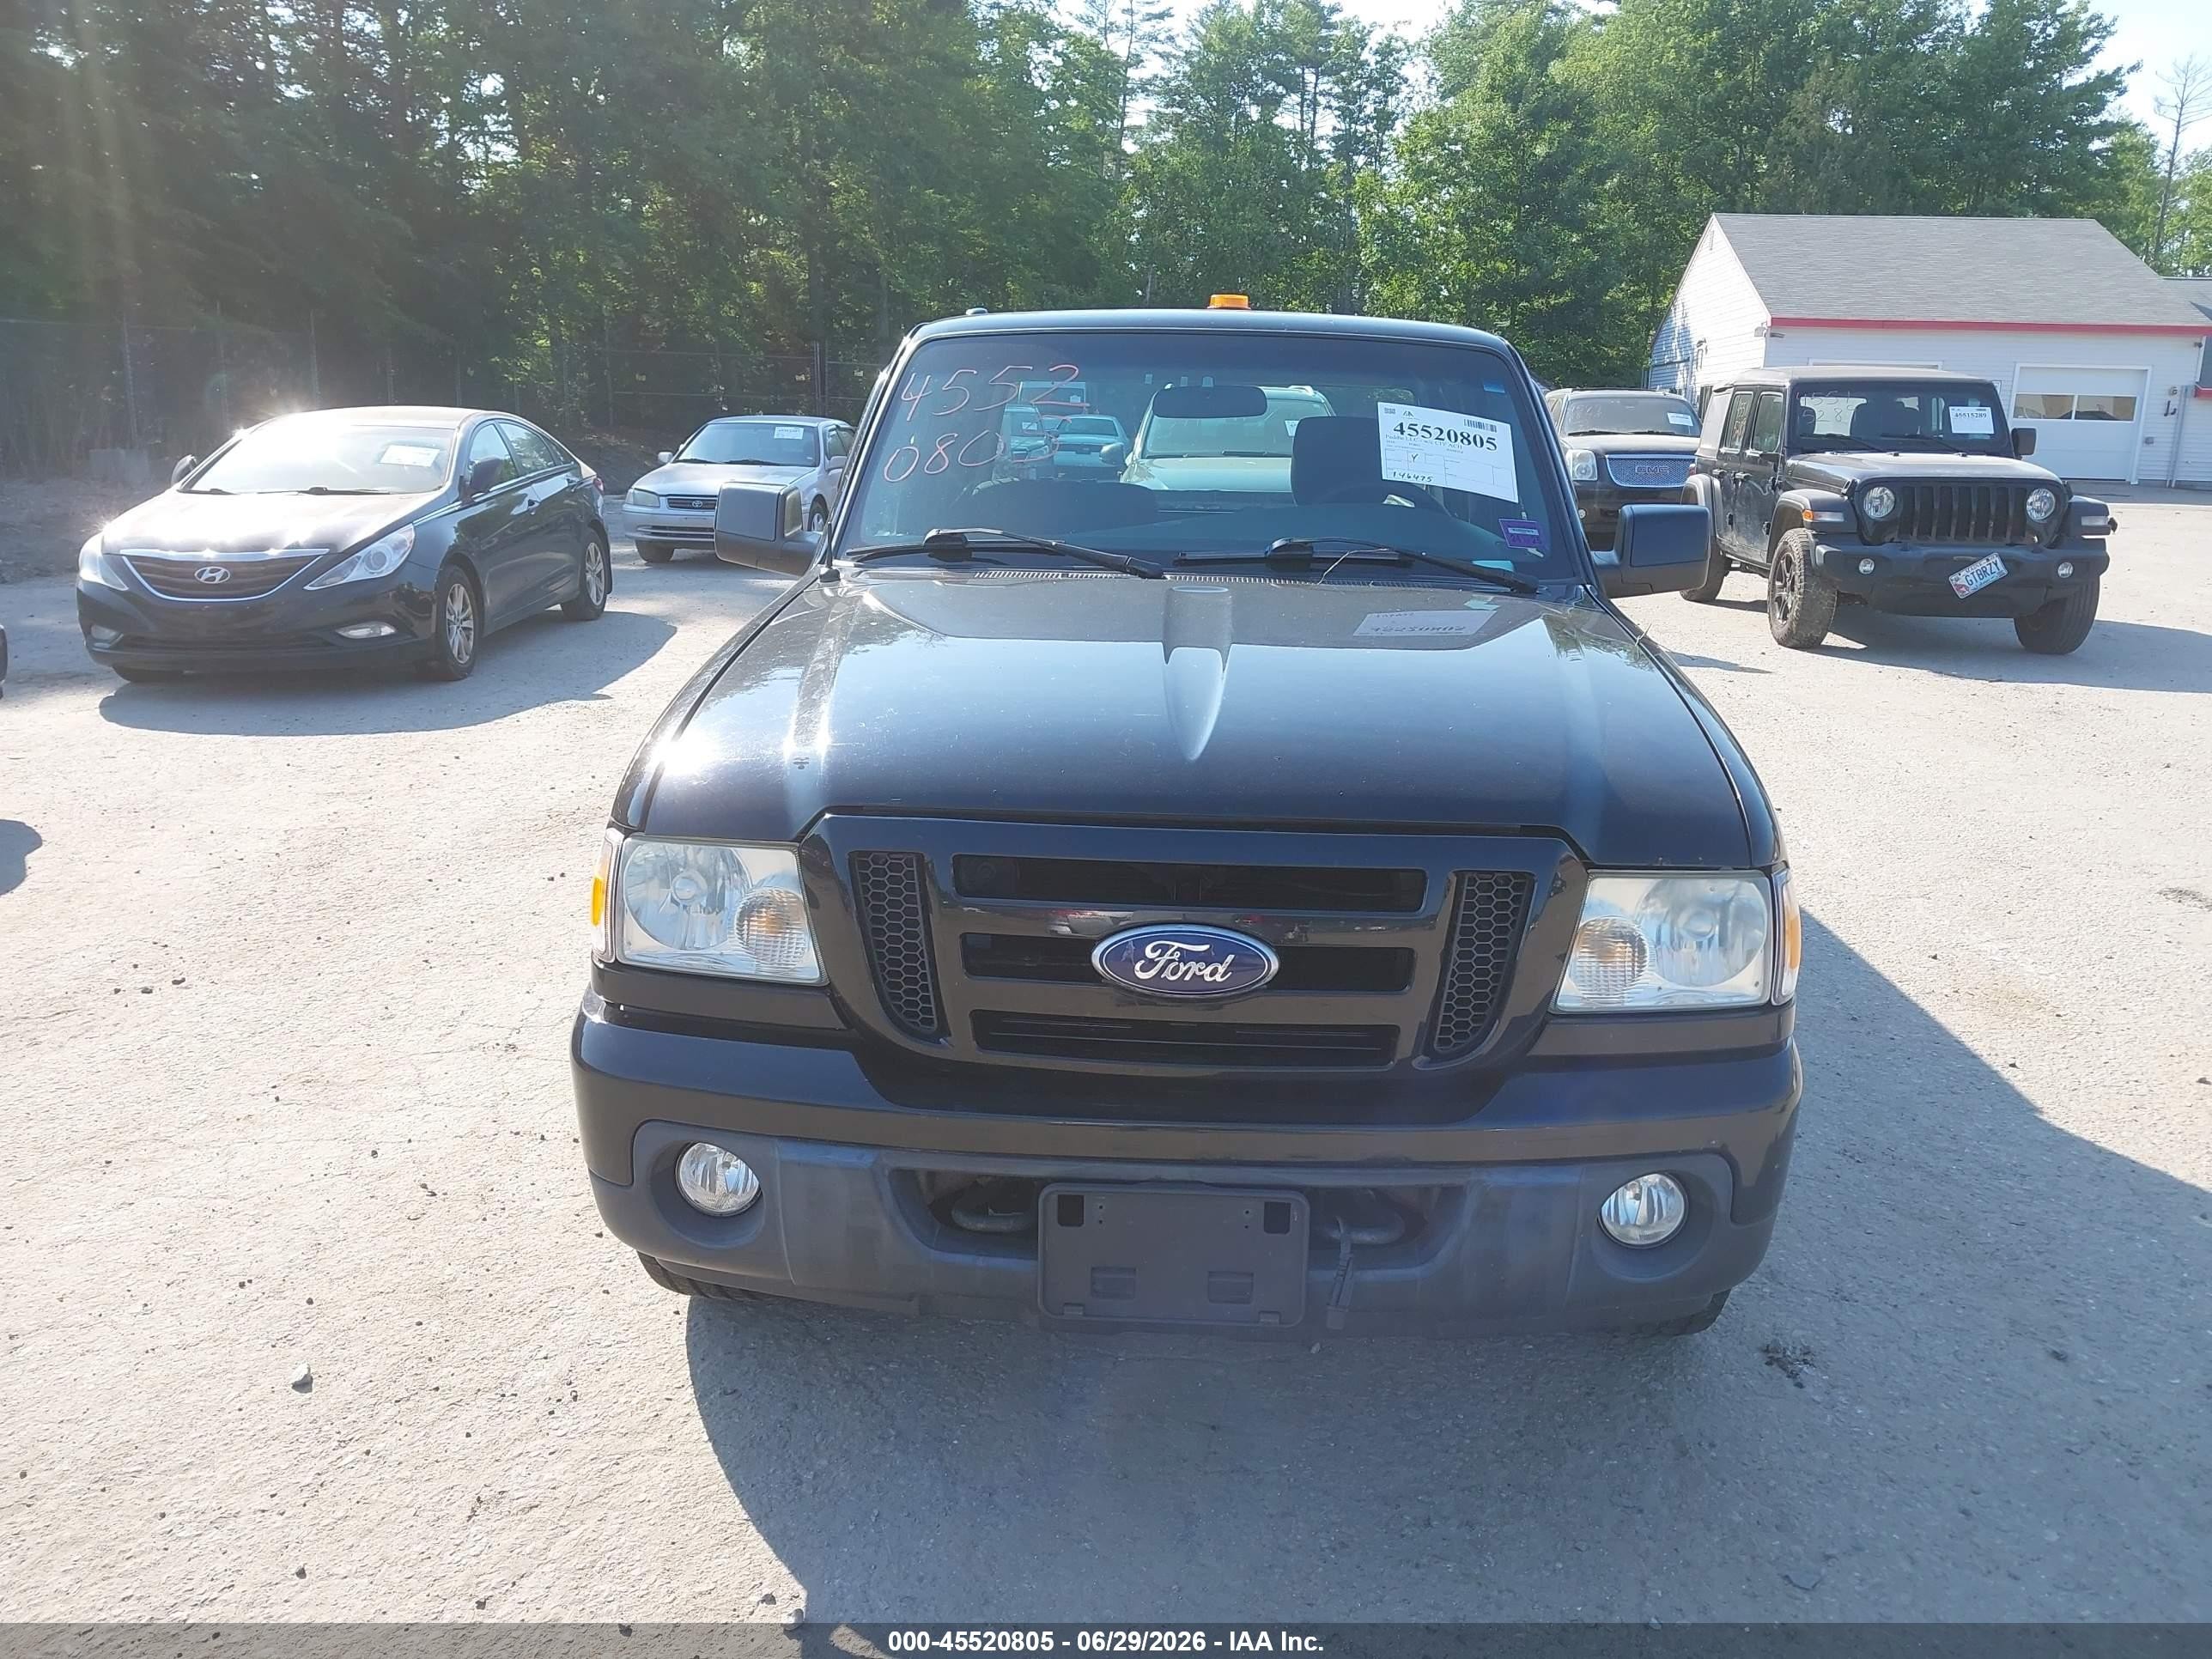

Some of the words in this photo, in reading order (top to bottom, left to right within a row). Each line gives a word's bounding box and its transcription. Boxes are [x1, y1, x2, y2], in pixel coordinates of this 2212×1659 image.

[901, 364, 1090, 421] 4552
[1393, 422, 1498, 451] 45520805
[1965, 559, 2001, 586] GTBRZY
[1133, 940, 1235, 981] Ford
